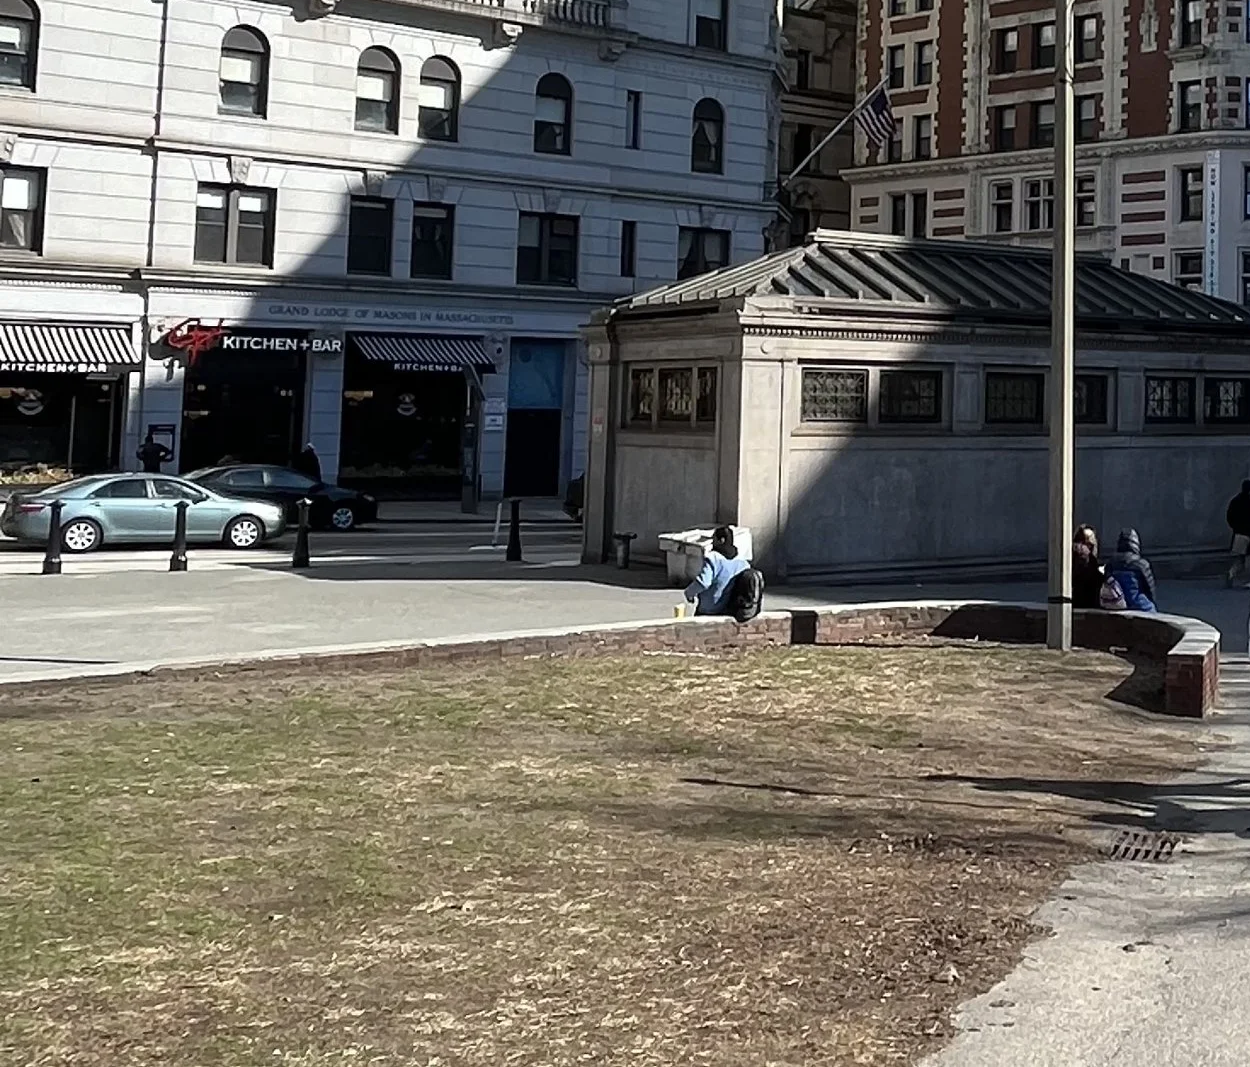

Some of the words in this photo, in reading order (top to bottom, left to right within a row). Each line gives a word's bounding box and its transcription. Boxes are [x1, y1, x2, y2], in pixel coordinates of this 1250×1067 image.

[268, 305, 309, 316] GRAND
[314, 307, 348, 317] LODGE
[355, 309, 369, 319] OF
[420, 312, 432, 322] IN
